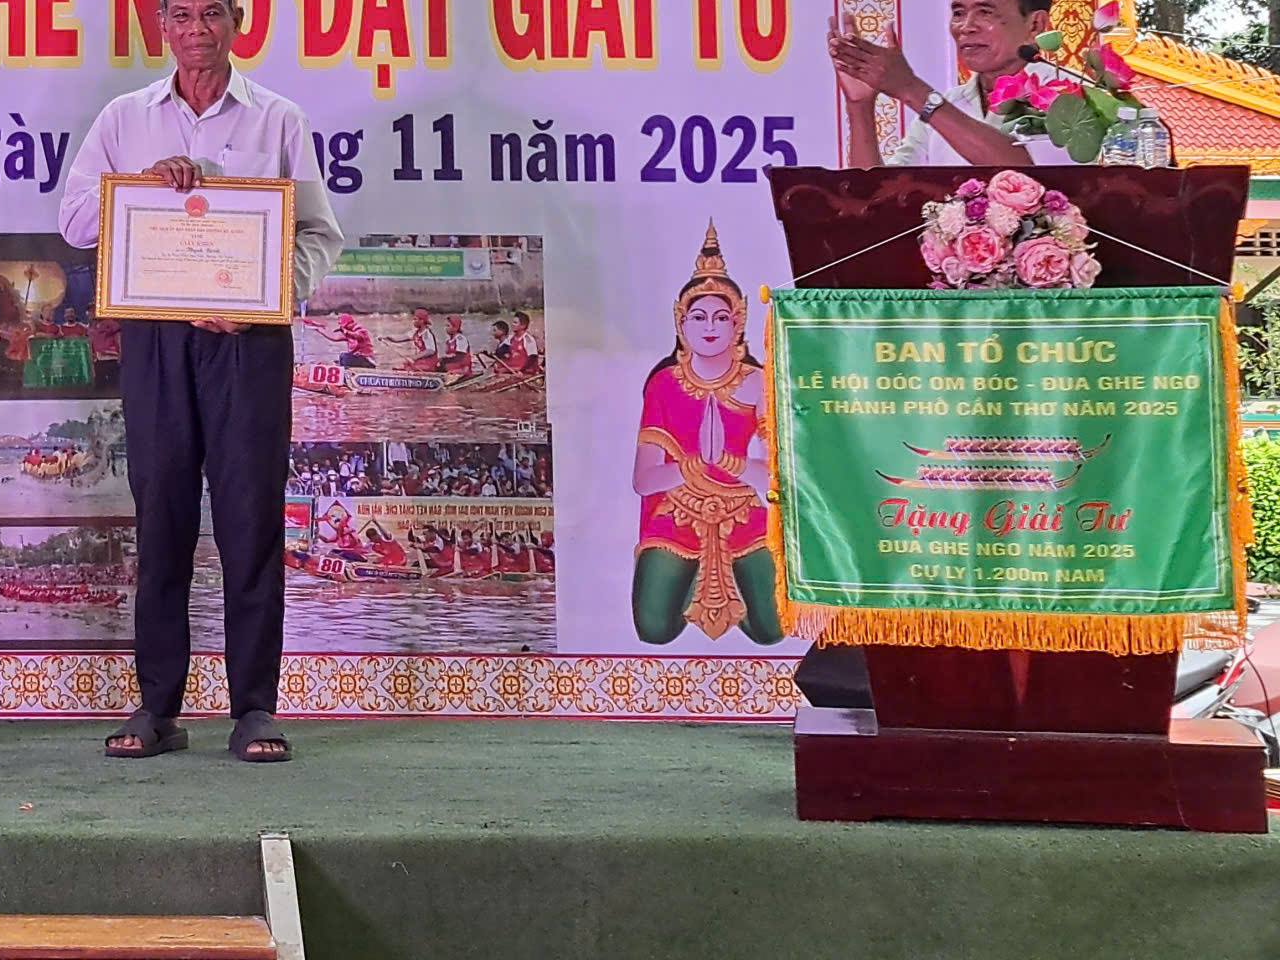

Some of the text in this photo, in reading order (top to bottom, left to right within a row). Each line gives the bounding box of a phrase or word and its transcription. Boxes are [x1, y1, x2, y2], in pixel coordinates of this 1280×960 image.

[392, 113, 463, 181] 11
[490, 119, 616, 183] năm
[640, 114, 799, 183] 2025
[875, 334, 1117, 364] BAN TỔ CHỨC
[312, 366, 340, 383] 08
[799, 371, 824, 389] LỄ
[832, 374, 869, 392] HỘI
[929, 376, 965, 390] OM
[1041, 376, 1090, 391] ĐUA
[1098, 376, 1145, 390] GHE
[1153, 375, 1201, 390] NGO
[1010, 401, 1058, 416] THƠ
[1124, 401, 1179, 416] 2025
[878, 497, 1133, 537] Tặng Giải Tư
[878, 539, 922, 554] ĐUA
[929, 541, 969, 556] GHE
[976, 542, 1021, 557] NGO
[1083, 543, 1135, 559] 2025
[945, 565, 966, 580] LY
[976, 567, 1048, 582] 1.200m
[1056, 569, 1105, 583] NAM
